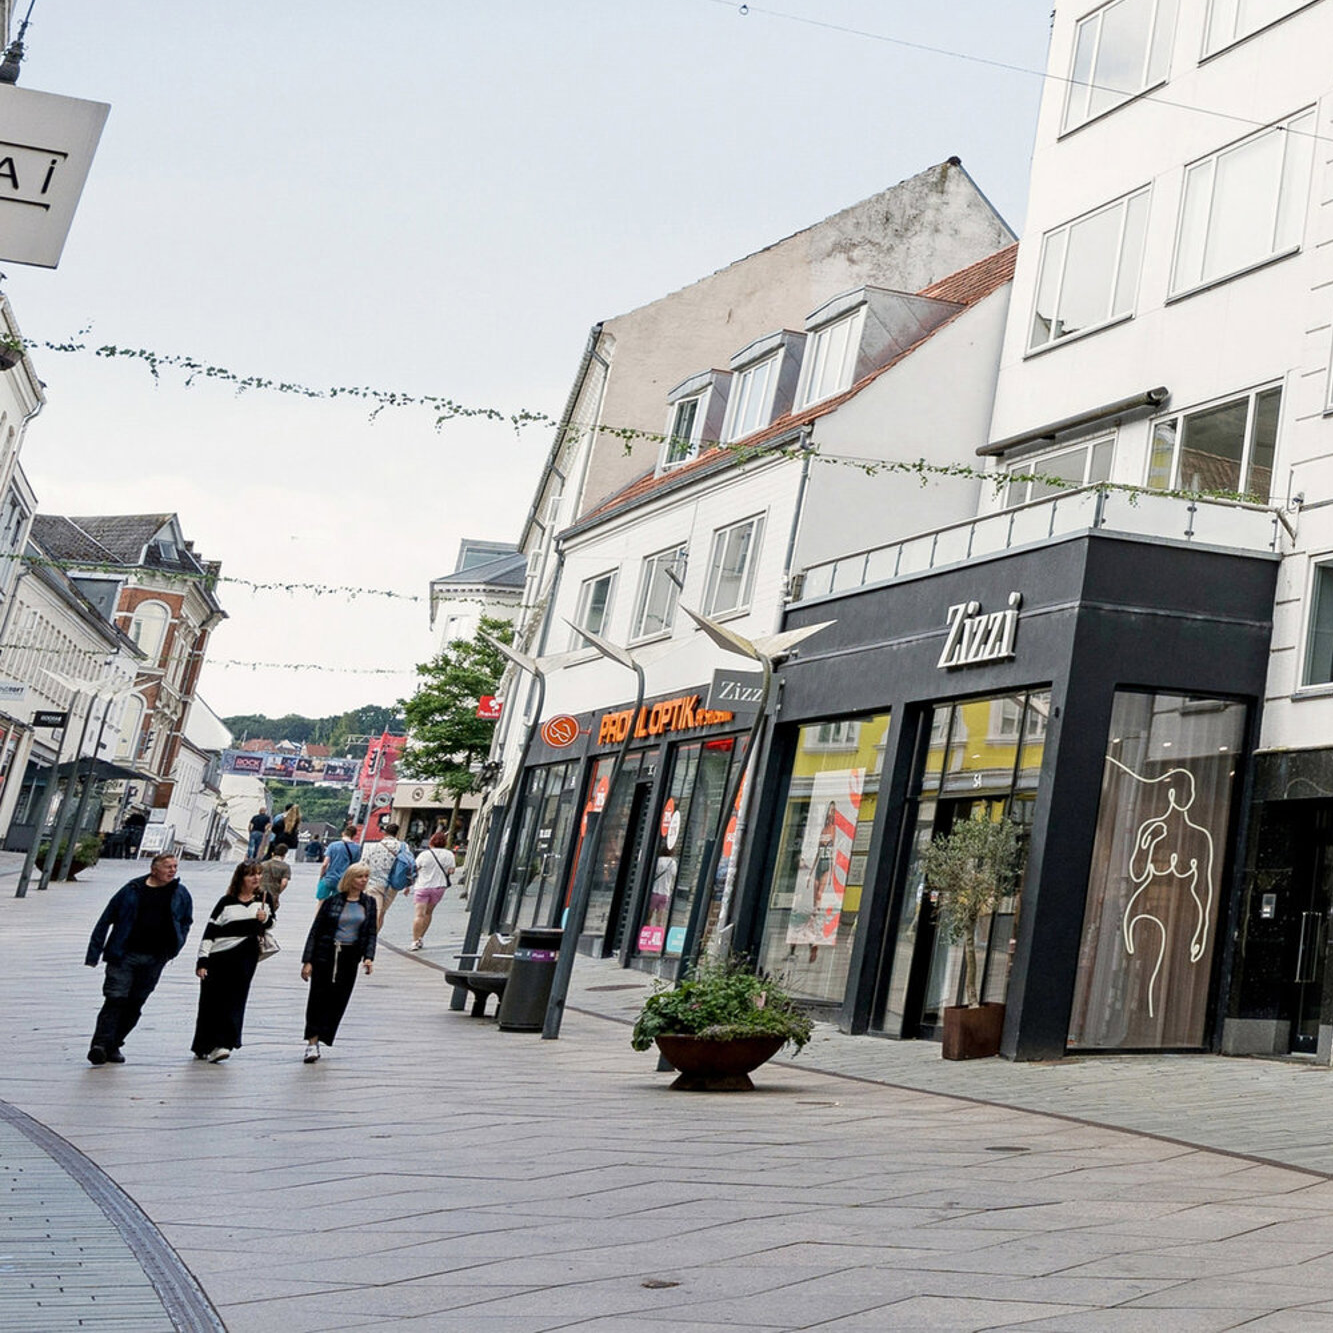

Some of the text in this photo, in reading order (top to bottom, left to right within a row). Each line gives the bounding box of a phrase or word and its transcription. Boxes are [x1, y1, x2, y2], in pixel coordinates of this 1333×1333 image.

[937, 591, 1024, 669] Zizzi
[719, 680, 766, 703] Zizz
[648, 694, 700, 736] OPTIK
